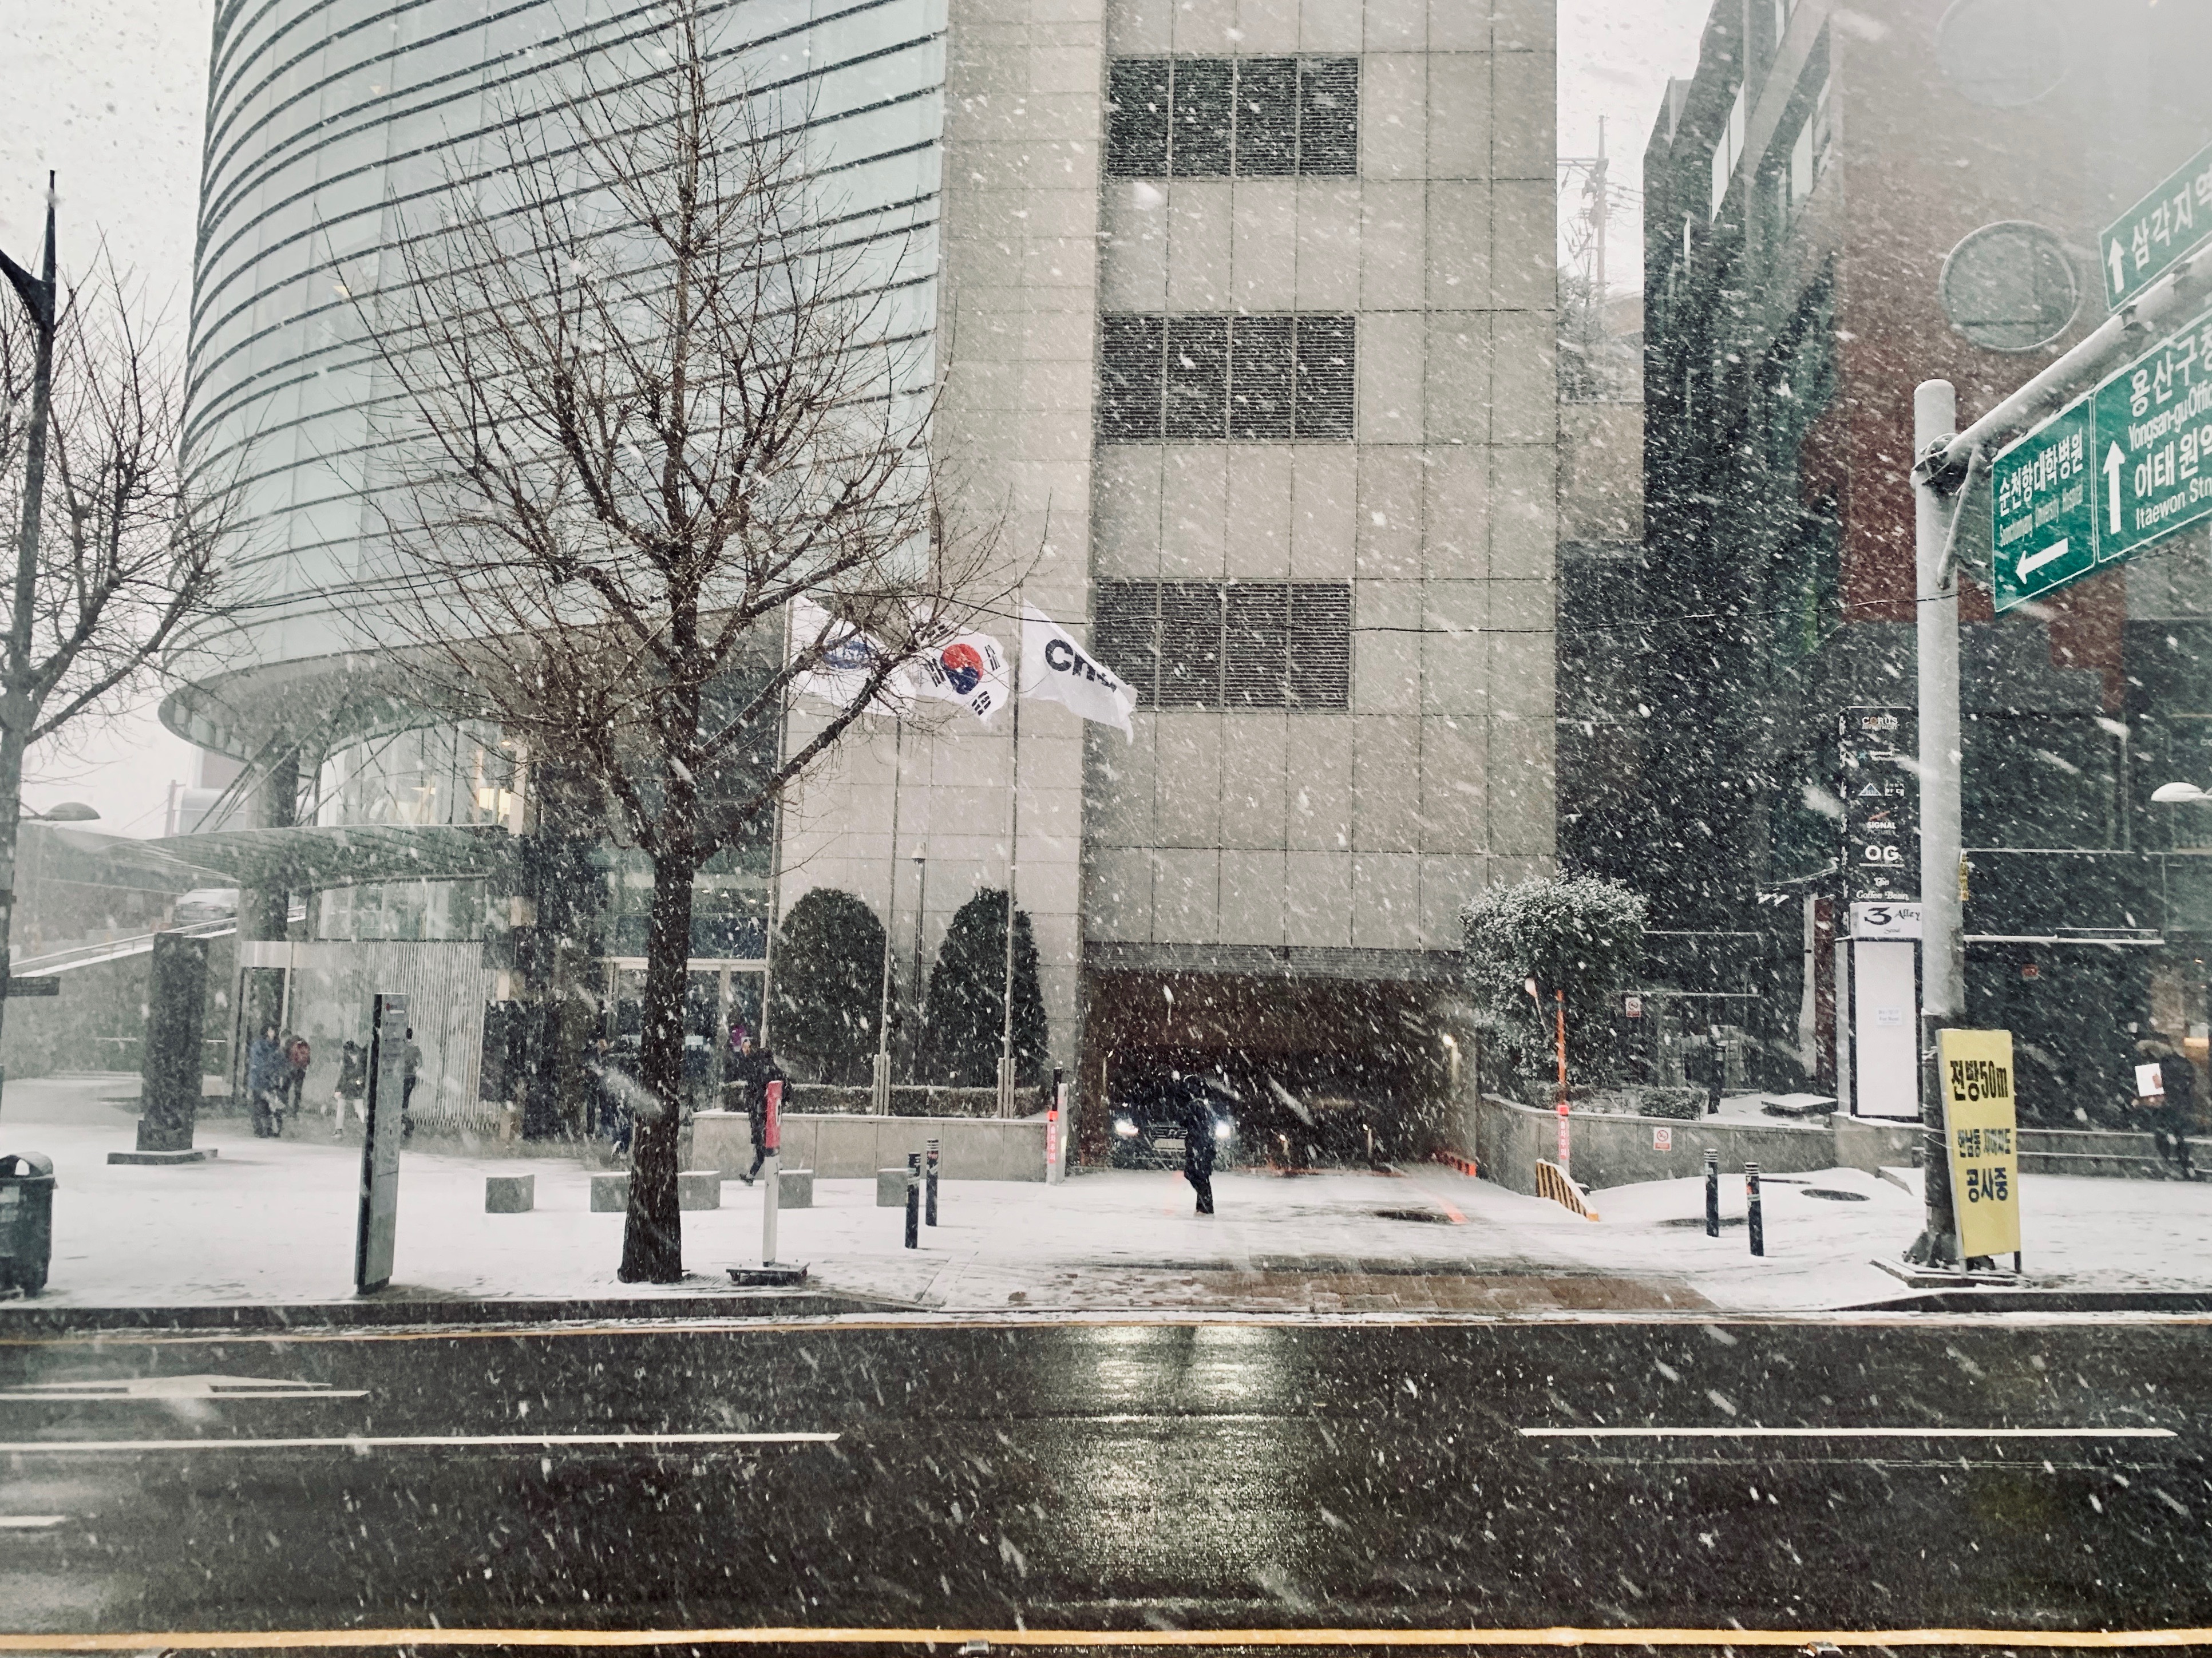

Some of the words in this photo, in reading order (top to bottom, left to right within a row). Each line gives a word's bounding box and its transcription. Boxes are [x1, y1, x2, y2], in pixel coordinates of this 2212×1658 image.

[1999, 426, 2083, 517] 순천향대학병원
[2136, 491, 2185, 530] Itaewon
[1862, 717, 1898, 725] CORUS
[1866, 821, 1897, 829] SIGNAL
[1865, 845, 1900, 861] OG
[1856, 890, 1882, 899] Coffee
[1884, 891, 1910, 901] Bean
[1864, 907, 1892, 925] 3
[1894, 909, 1921, 921] Alley
[1950, 1061, 2008, 1102] 전방50m
[1966, 1167, 2008, 1202] 공사중
